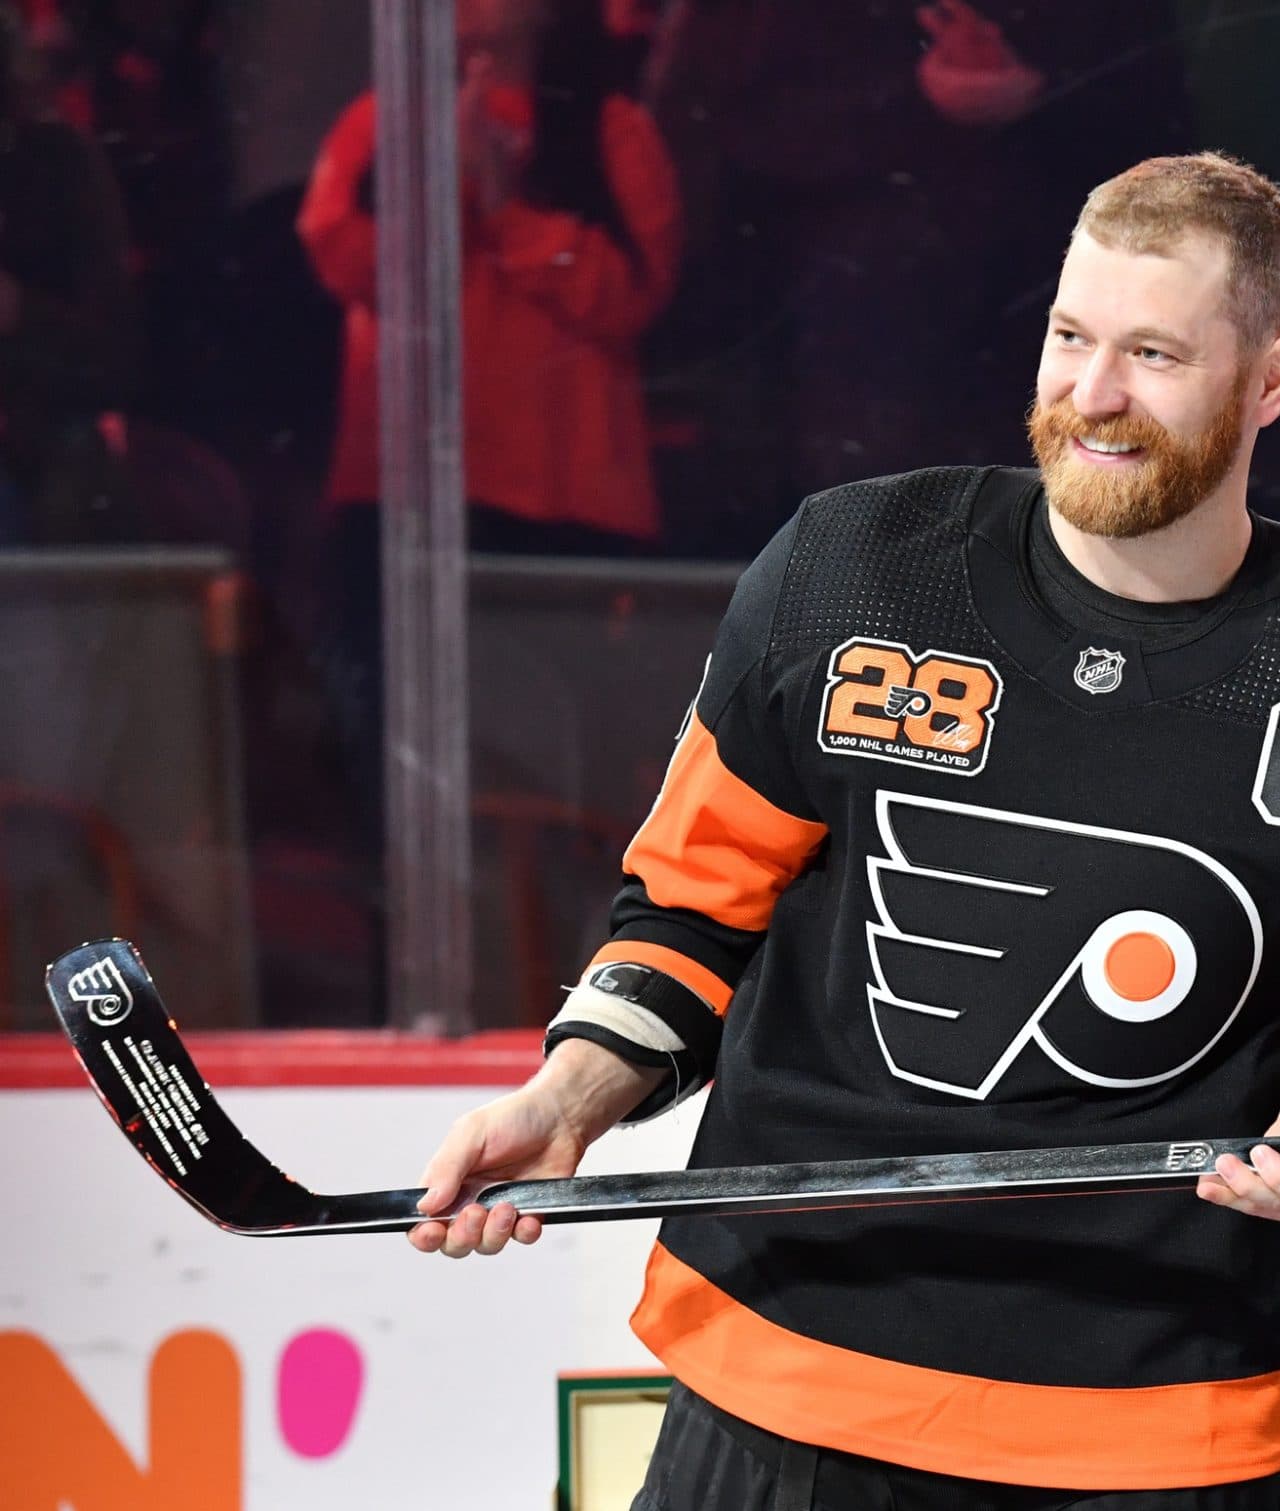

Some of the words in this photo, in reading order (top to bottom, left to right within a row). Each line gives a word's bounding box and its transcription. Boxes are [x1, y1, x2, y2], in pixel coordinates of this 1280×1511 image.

[1084, 661, 1116, 681] NHL
[826, 645, 994, 752] 28
[829, 735, 857, 747] 1,000
[859, 739, 882, 751] NHL
[885, 744, 924, 759] GAMES
[926, 751, 970, 767] PLAYED
